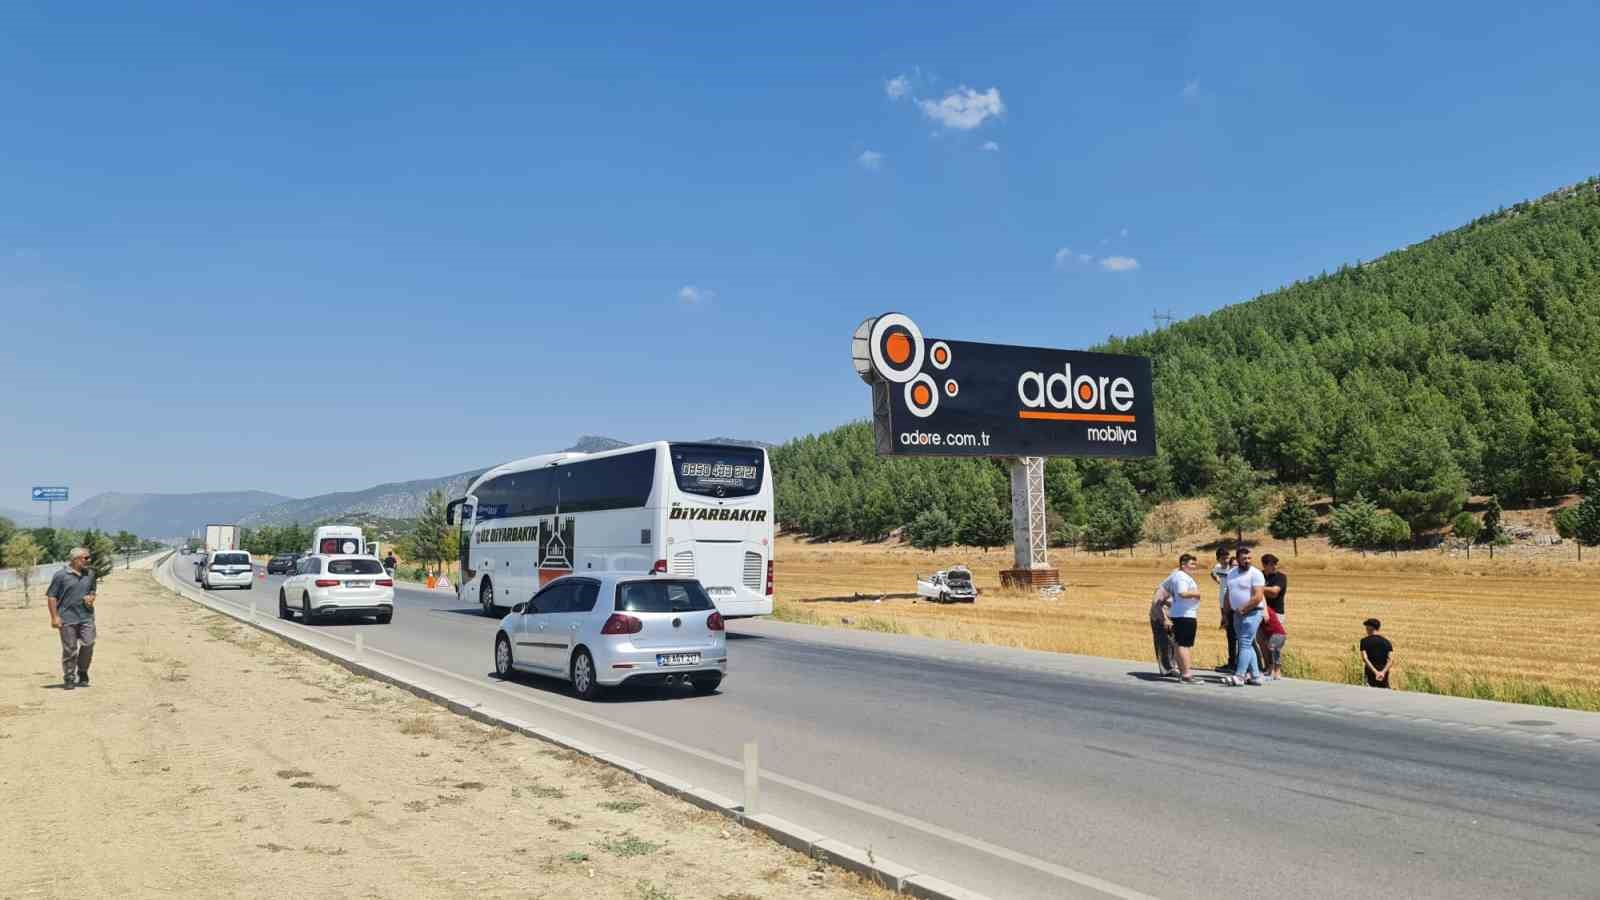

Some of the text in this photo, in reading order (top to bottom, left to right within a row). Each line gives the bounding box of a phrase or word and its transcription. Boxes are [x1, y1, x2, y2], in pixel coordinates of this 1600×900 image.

[1018, 362, 1135, 411] adore
[900, 430, 991, 446] adore.com.tr
[1087, 426, 1137, 444] mobilya
